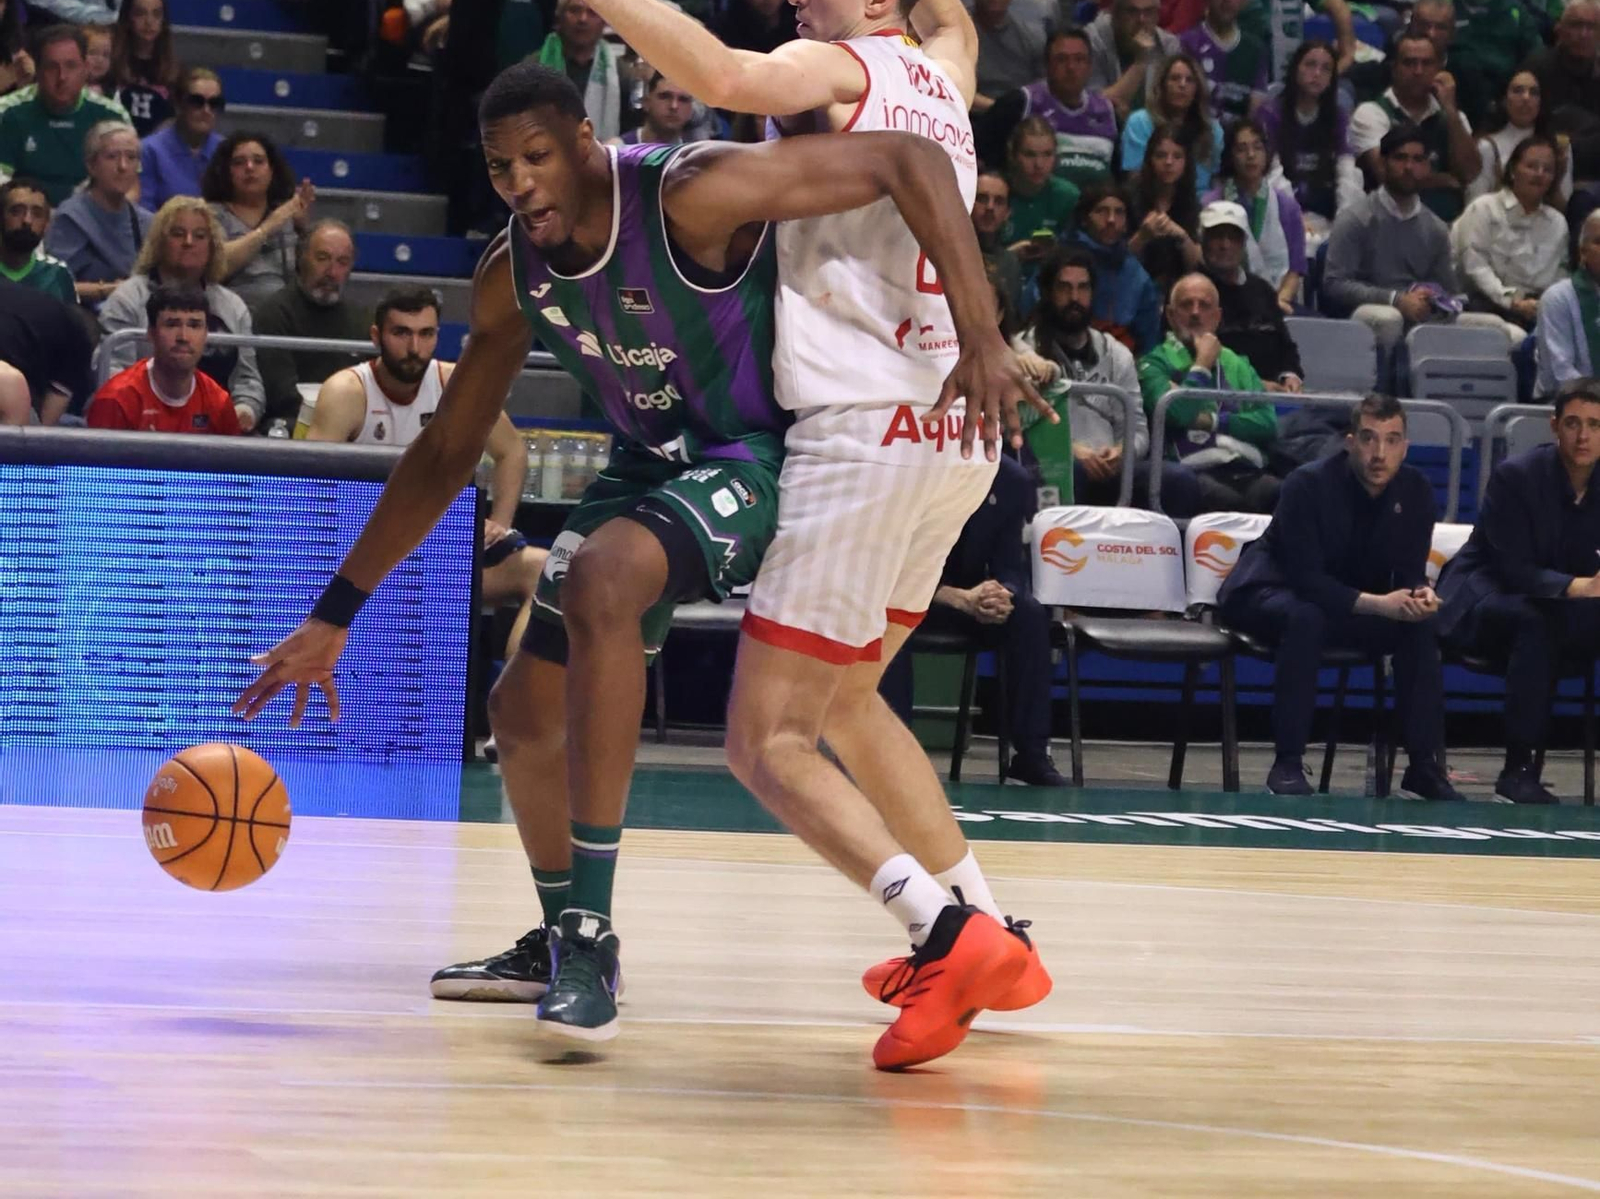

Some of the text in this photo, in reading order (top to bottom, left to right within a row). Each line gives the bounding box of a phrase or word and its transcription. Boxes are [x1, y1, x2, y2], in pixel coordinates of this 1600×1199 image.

[919, 339, 959, 351] MANRES
[1097, 543, 1179, 556] COSTA DEL SOL
